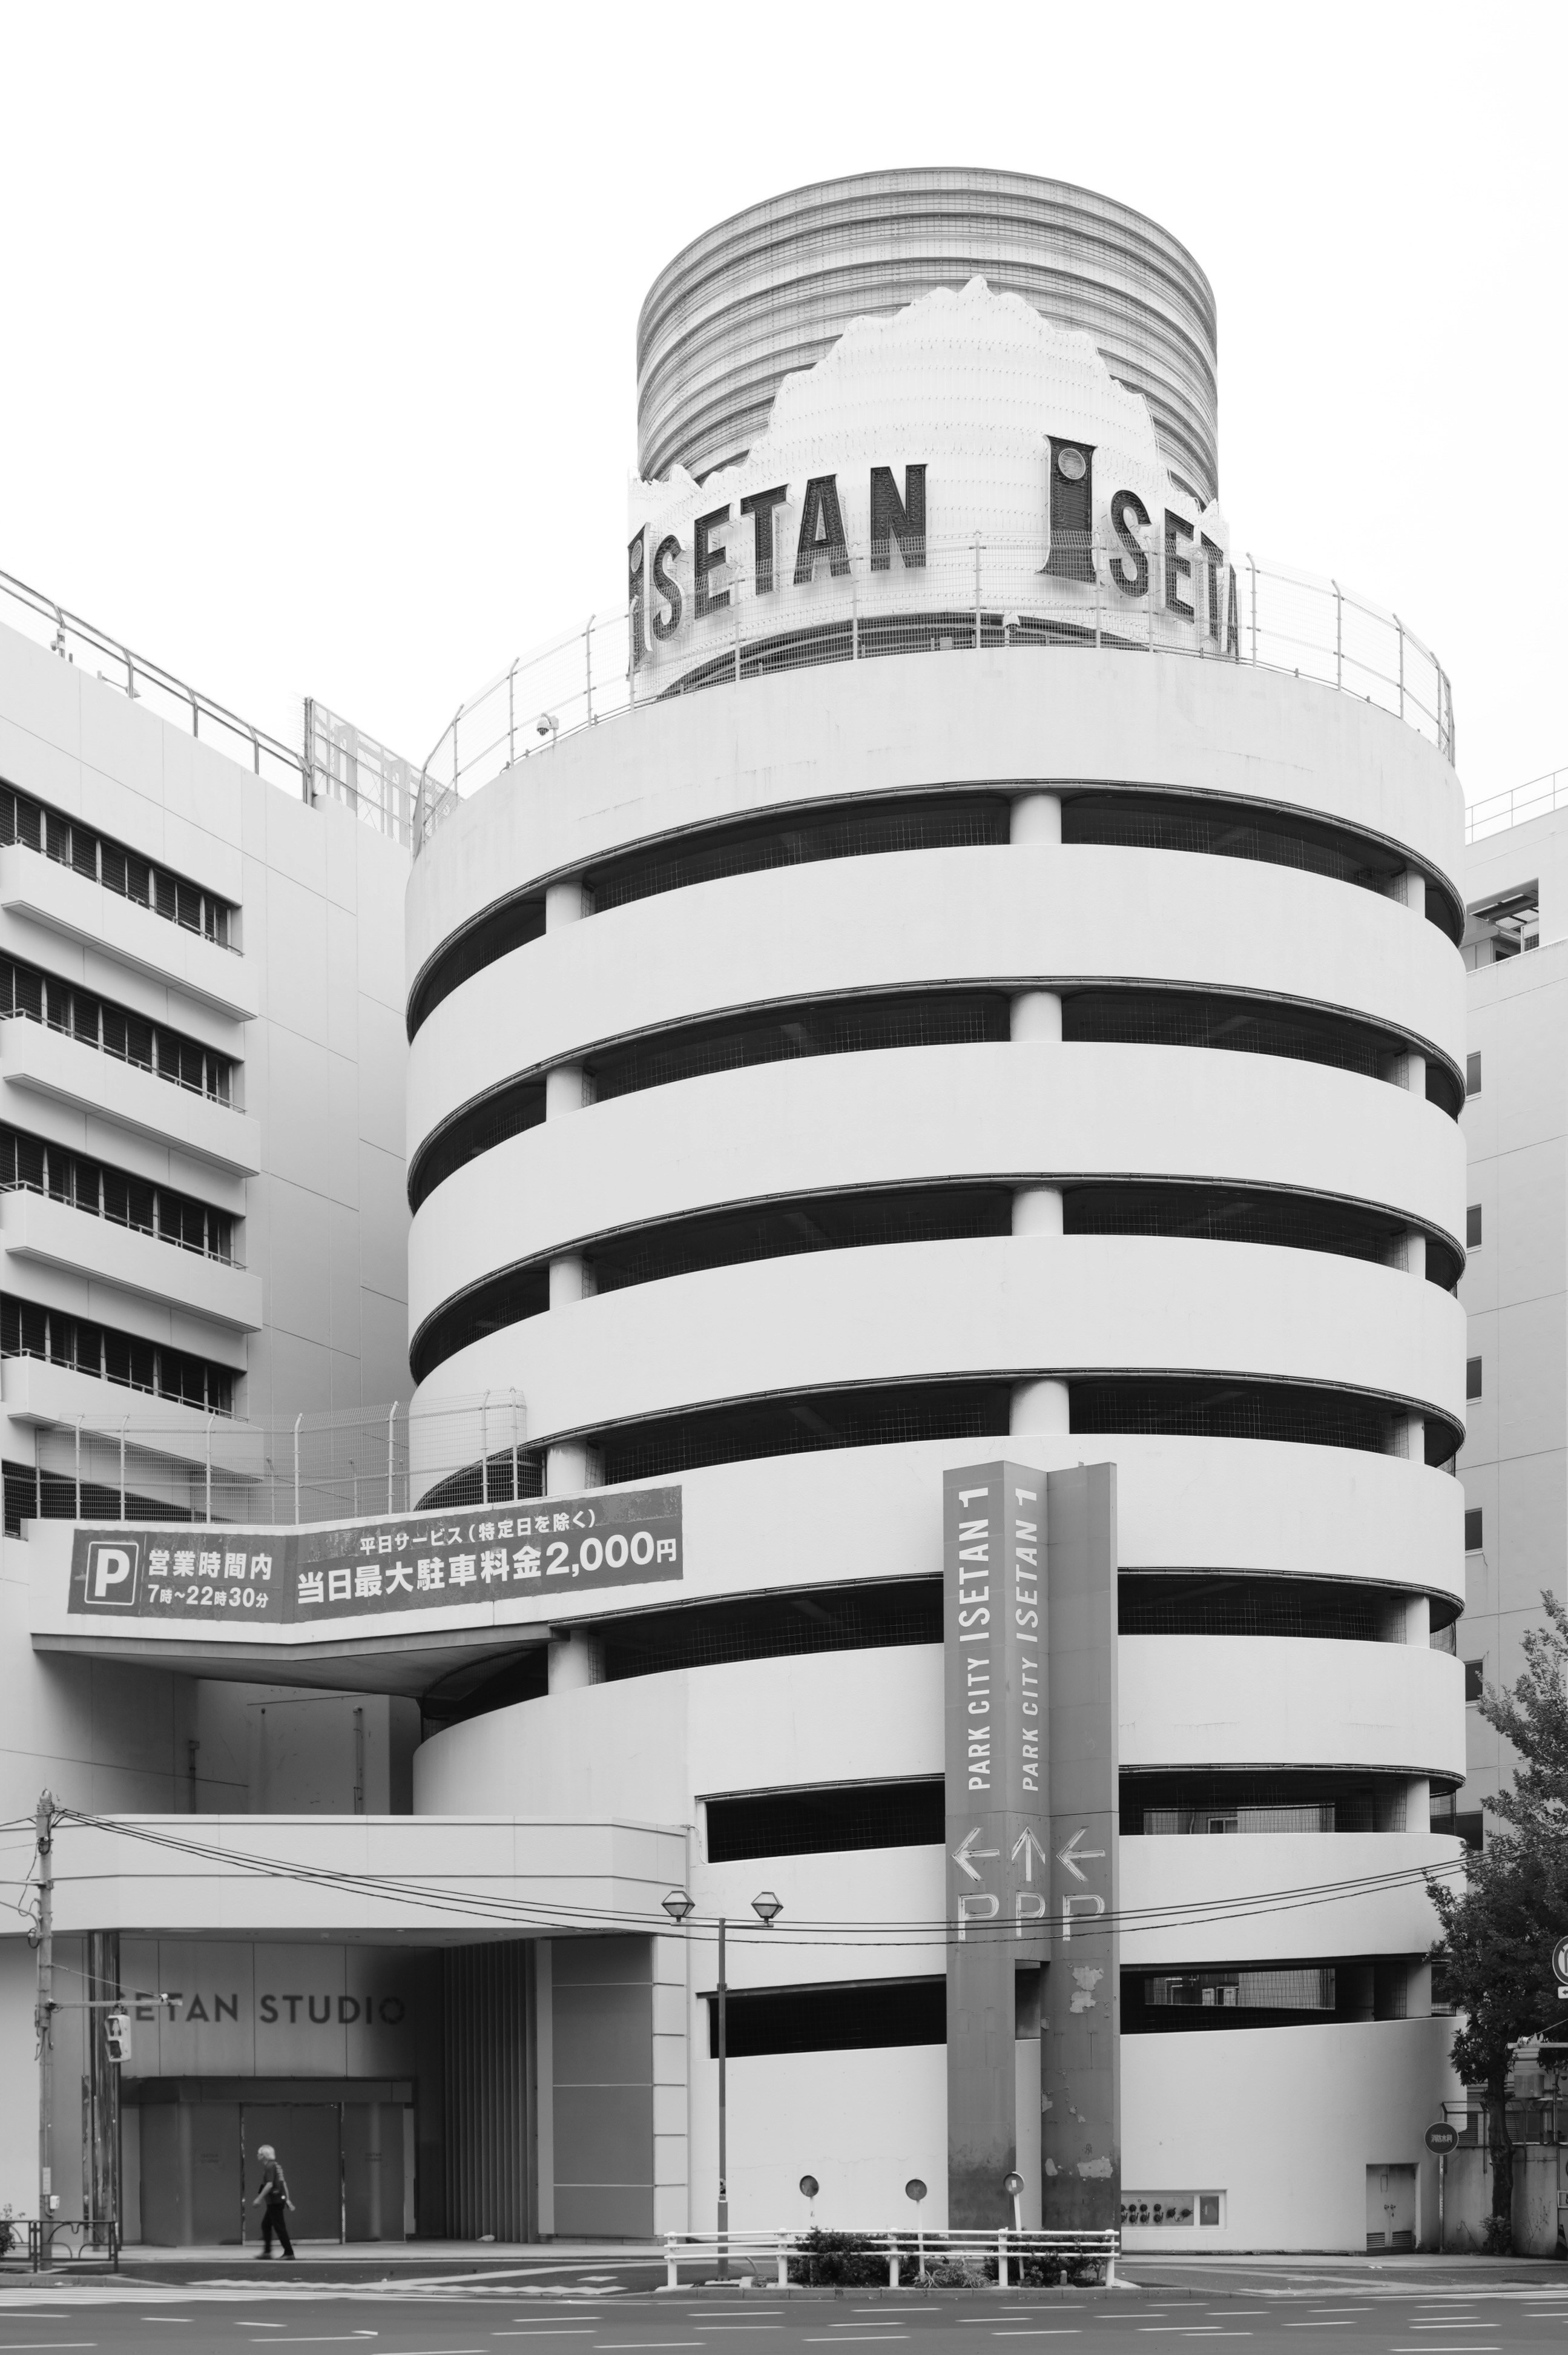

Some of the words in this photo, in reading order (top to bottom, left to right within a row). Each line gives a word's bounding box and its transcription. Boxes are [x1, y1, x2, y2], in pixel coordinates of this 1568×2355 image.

[627, 463, 929, 676] ISETAN
[959, 1487, 989, 1508] 1
[1015, 1487, 1037, 1506] 1
[94, 1548, 130, 1597] P
[148, 1550, 272, 1580] 営業時間内
[297, 1531, 677, 1604] 当日最大駐車料金2,000円
[959, 1519, 990, 1642] ISETAN
[1015, 1519, 1038, 1643] ISETAN
[967, 1657, 990, 1715] CITY
[1022, 1656, 1038, 1716] CITY
[969, 1725, 990, 1791] PARK
[1023, 1727, 1038, 1791] PARK
[119, 1992, 238, 2022] ETAN
[260, 1994, 406, 2024] STUDIO
